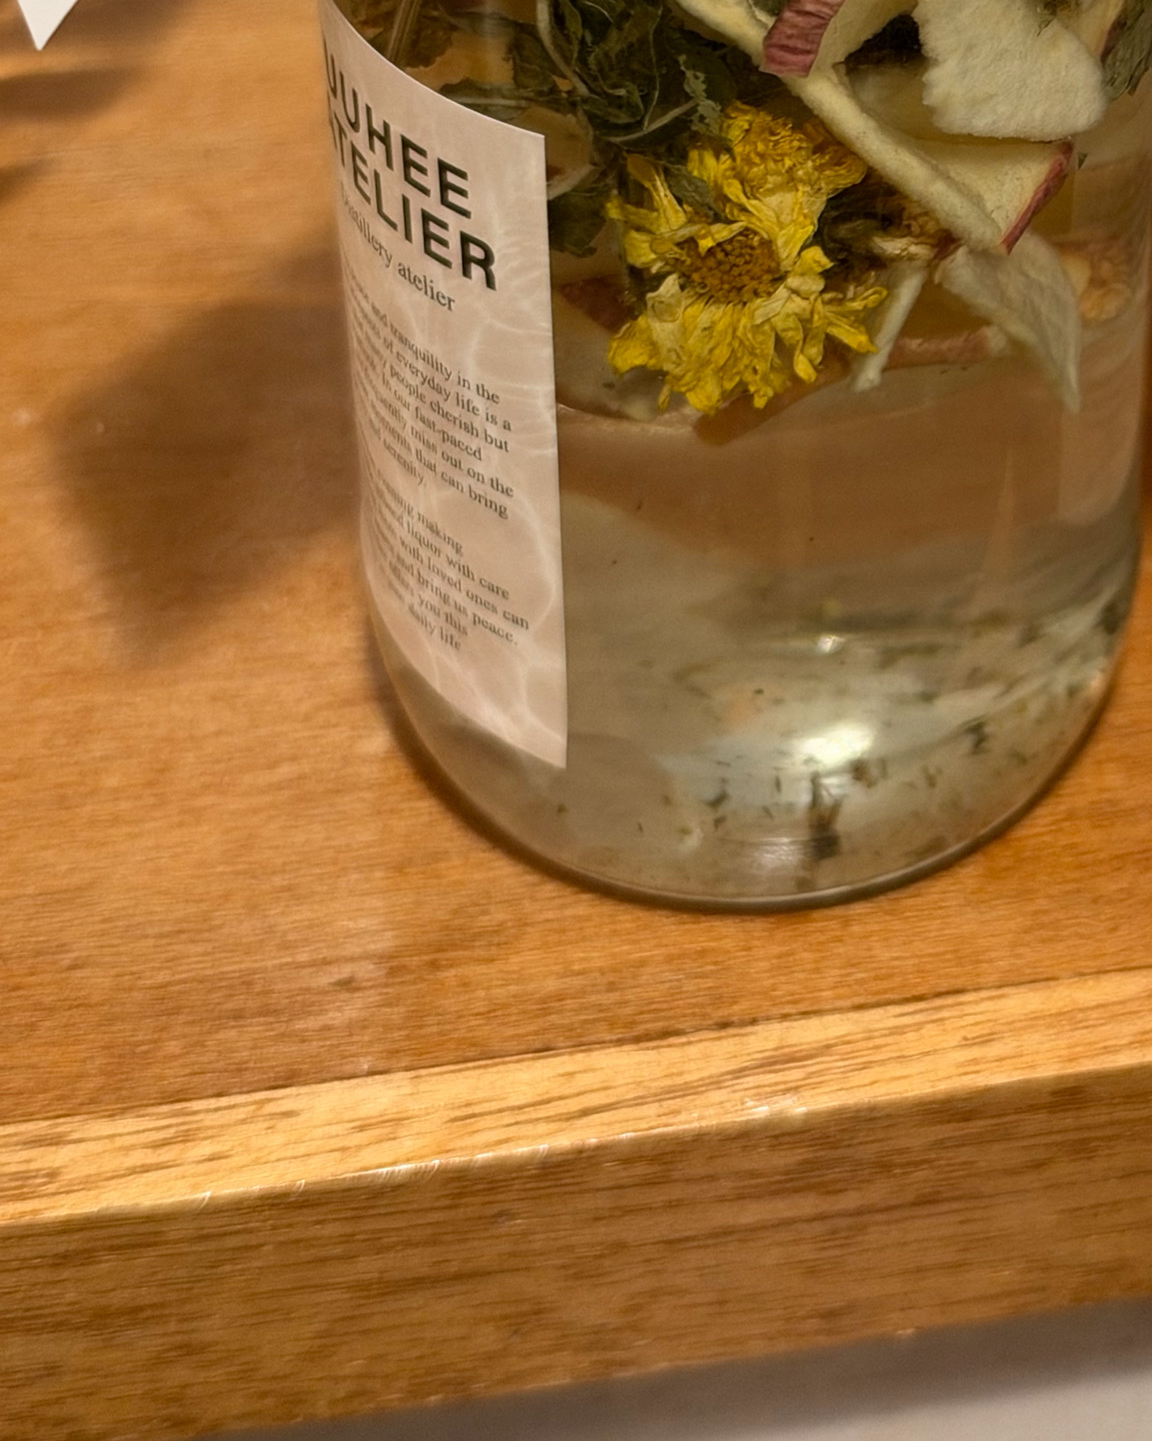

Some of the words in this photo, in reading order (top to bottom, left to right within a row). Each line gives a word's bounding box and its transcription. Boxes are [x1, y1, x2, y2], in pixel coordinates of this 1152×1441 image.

[396, 261, 455, 311] atelier
[390, 321, 451, 381] tranquility
[457, 370, 471, 391] in
[476, 382, 499, 406] the
[396, 350, 451, 402] everyday
[455, 391, 480, 417] life
[485, 407, 498, 427] is
[503, 420, 512, 432] a
[390, 364, 427, 405] people
[429, 399, 479, 439] cherish
[484, 428, 510, 453] but
[394, 388, 411, 411] our
[415, 405, 482, 461] fast-paced
[410, 424, 438, 456] miss
[441, 449, 464, 472] out
[467, 465, 485, 484] on
[490, 476, 514, 499] the
[414, 447, 438, 475] that
[440, 470, 464, 494] can
[468, 484, 508, 520] bring
[407, 519, 441, 558] liquor
[446, 553, 475, 582] with
[479, 576, 510, 600] care
[418, 510, 463, 558] making
[418, 569, 450, 607] bring
[472, 611, 518, 646] peace.
[418, 593, 441, 620] you
[445, 610, 468, 637] this
[428, 556, 462, 592] loved
[466, 587, 498, 614] ones
[502, 609, 529, 631] can
[440, 626, 462, 651] life
